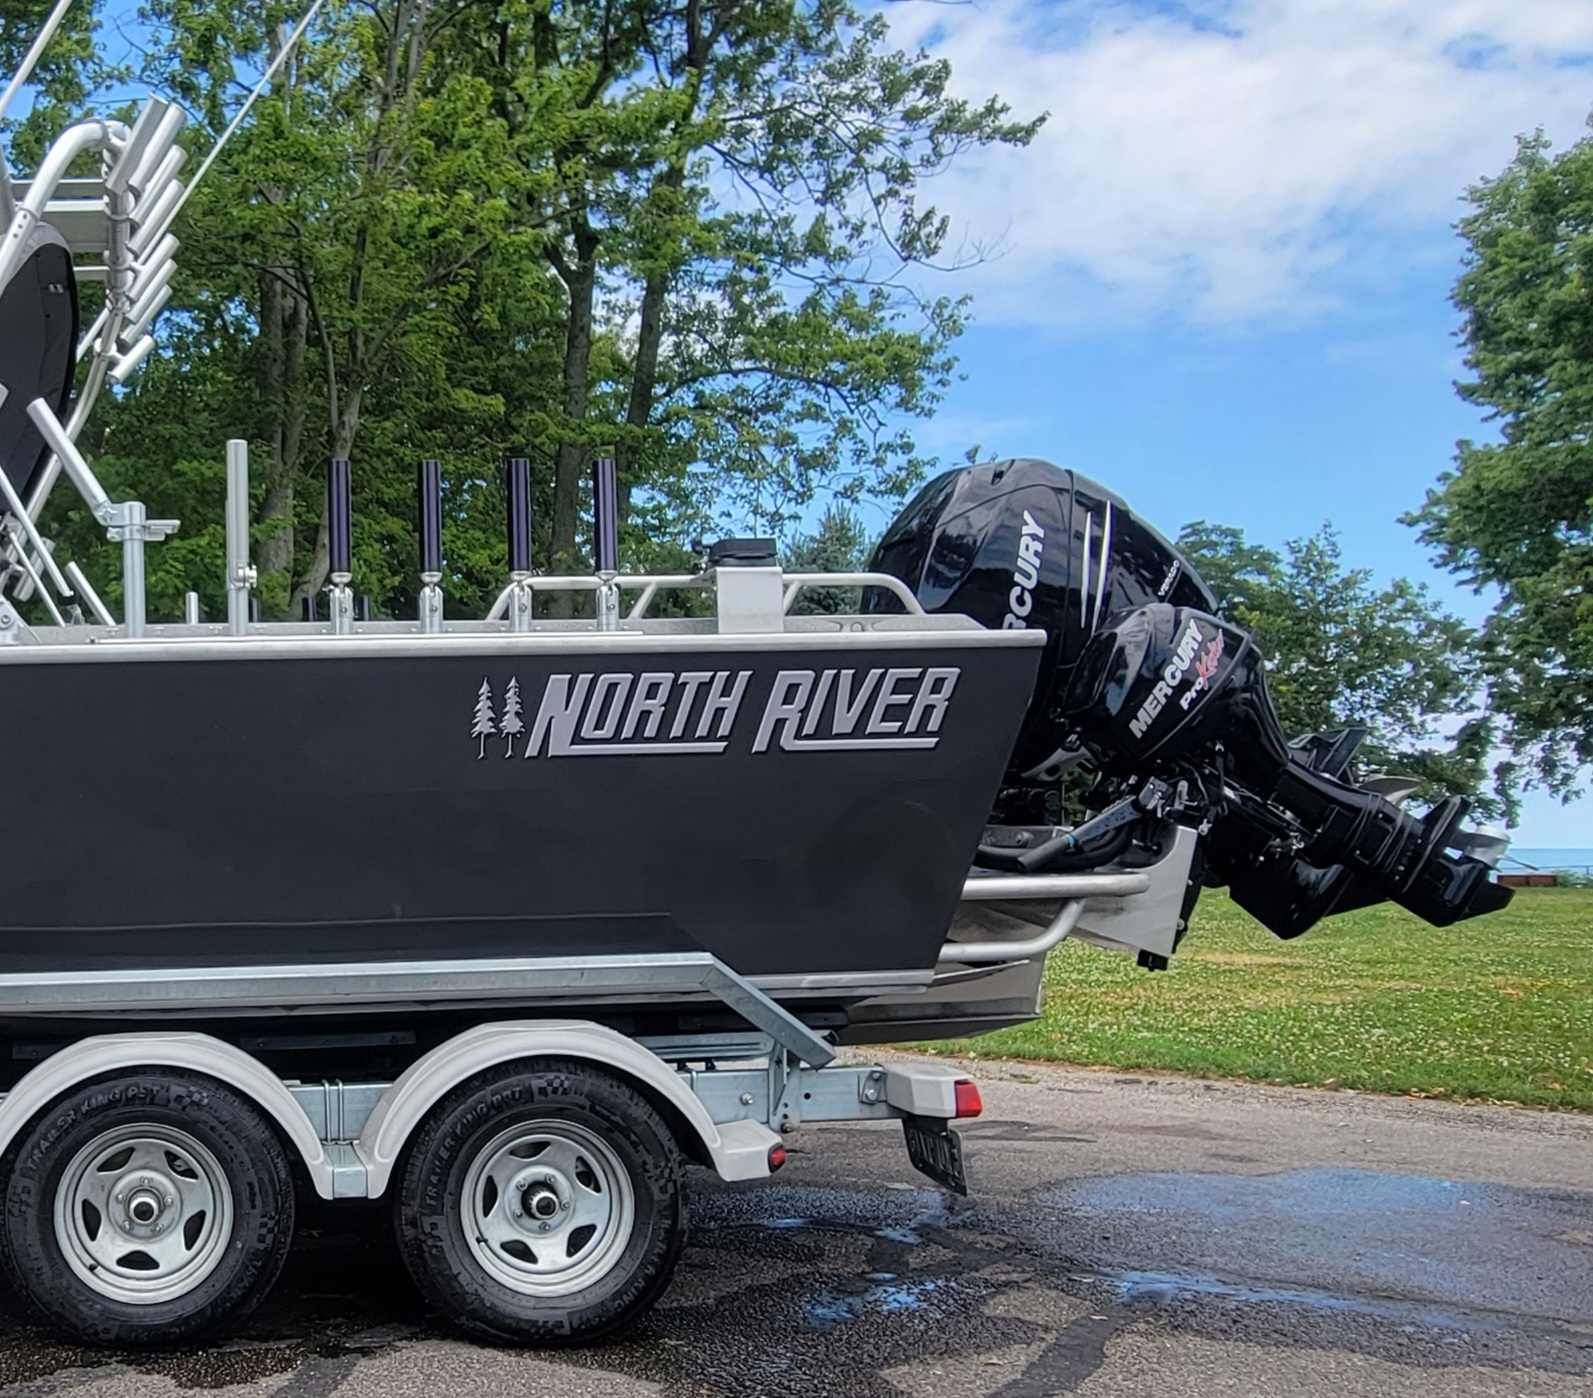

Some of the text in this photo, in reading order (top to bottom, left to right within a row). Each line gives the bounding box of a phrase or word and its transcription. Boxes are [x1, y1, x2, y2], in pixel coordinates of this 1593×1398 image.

[1002, 509, 1047, 630] RCURY
[525, 667, 962, 759] NORTH RIVER
[1129, 618, 1203, 739] MERCURY
[26, 1110, 77, 1171] TRAILER
[81, 1089, 122, 1115] KING
